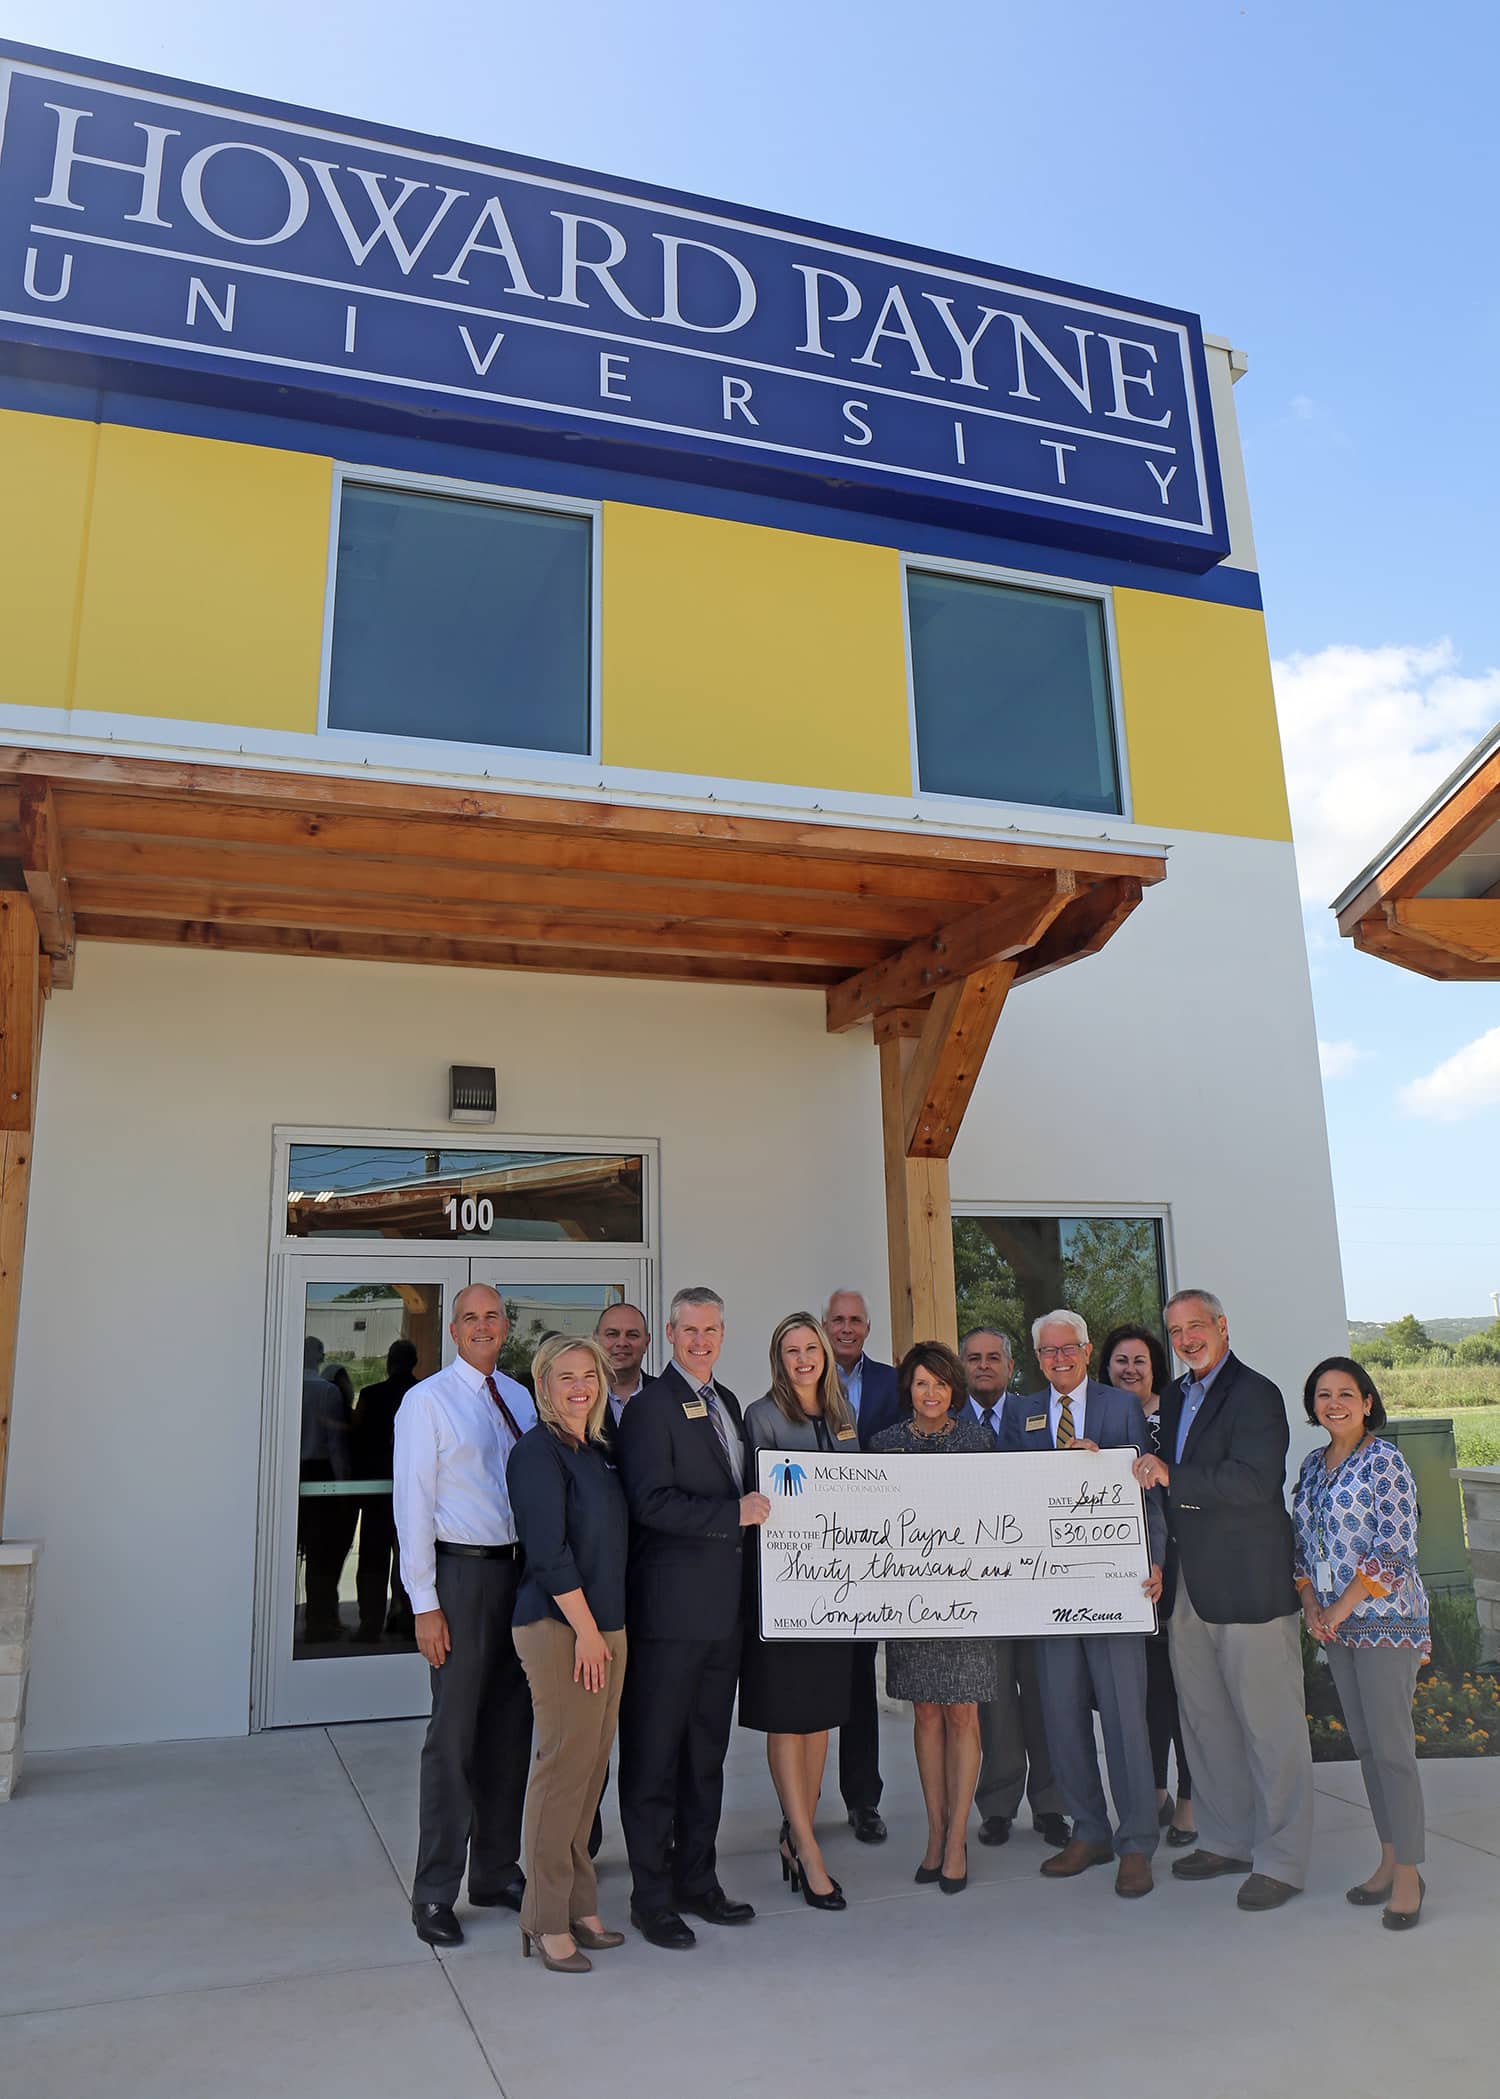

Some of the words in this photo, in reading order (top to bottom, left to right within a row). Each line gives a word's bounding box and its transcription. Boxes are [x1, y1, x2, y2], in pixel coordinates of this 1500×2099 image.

[34, 102, 757, 334] HOWARD
[792, 264, 1173, 428] PAYNE
[23, 247, 1178, 505] UNIVERSITY
[444, 1198, 494, 1231] 100
[814, 1483, 846, 1493] LEGACY
[848, 1484, 901, 1494] FOUNDATION
[1070, 1481, 1108, 1514] Sept
[1112, 1484, 1123, 1504] 8
[766, 1541, 799, 1551] ORDER
[800, 1541, 813, 1551] OF
[767, 1530, 786, 1540] PAY
[787, 1530, 801, 1540] TO
[802, 1530, 820, 1540] THE
[816, 1511, 894, 1550] Howard
[897, 1508, 965, 1558] Payne
[975, 1514, 1024, 1545] NB
[1054, 1522, 1131, 1545] $30,000
[776, 1549, 857, 1604] Thirty
[860, 1552, 979, 1581] thousand
[981, 1561, 1012, 1577] and
[1104, 1571, 1138, 1579] DOLLARS
[773, 1618, 808, 1629] MEMO
[811, 1595, 903, 1635] Computer
[908, 1594, 979, 1625] Center
[1051, 1607, 1123, 1623] McKenna
